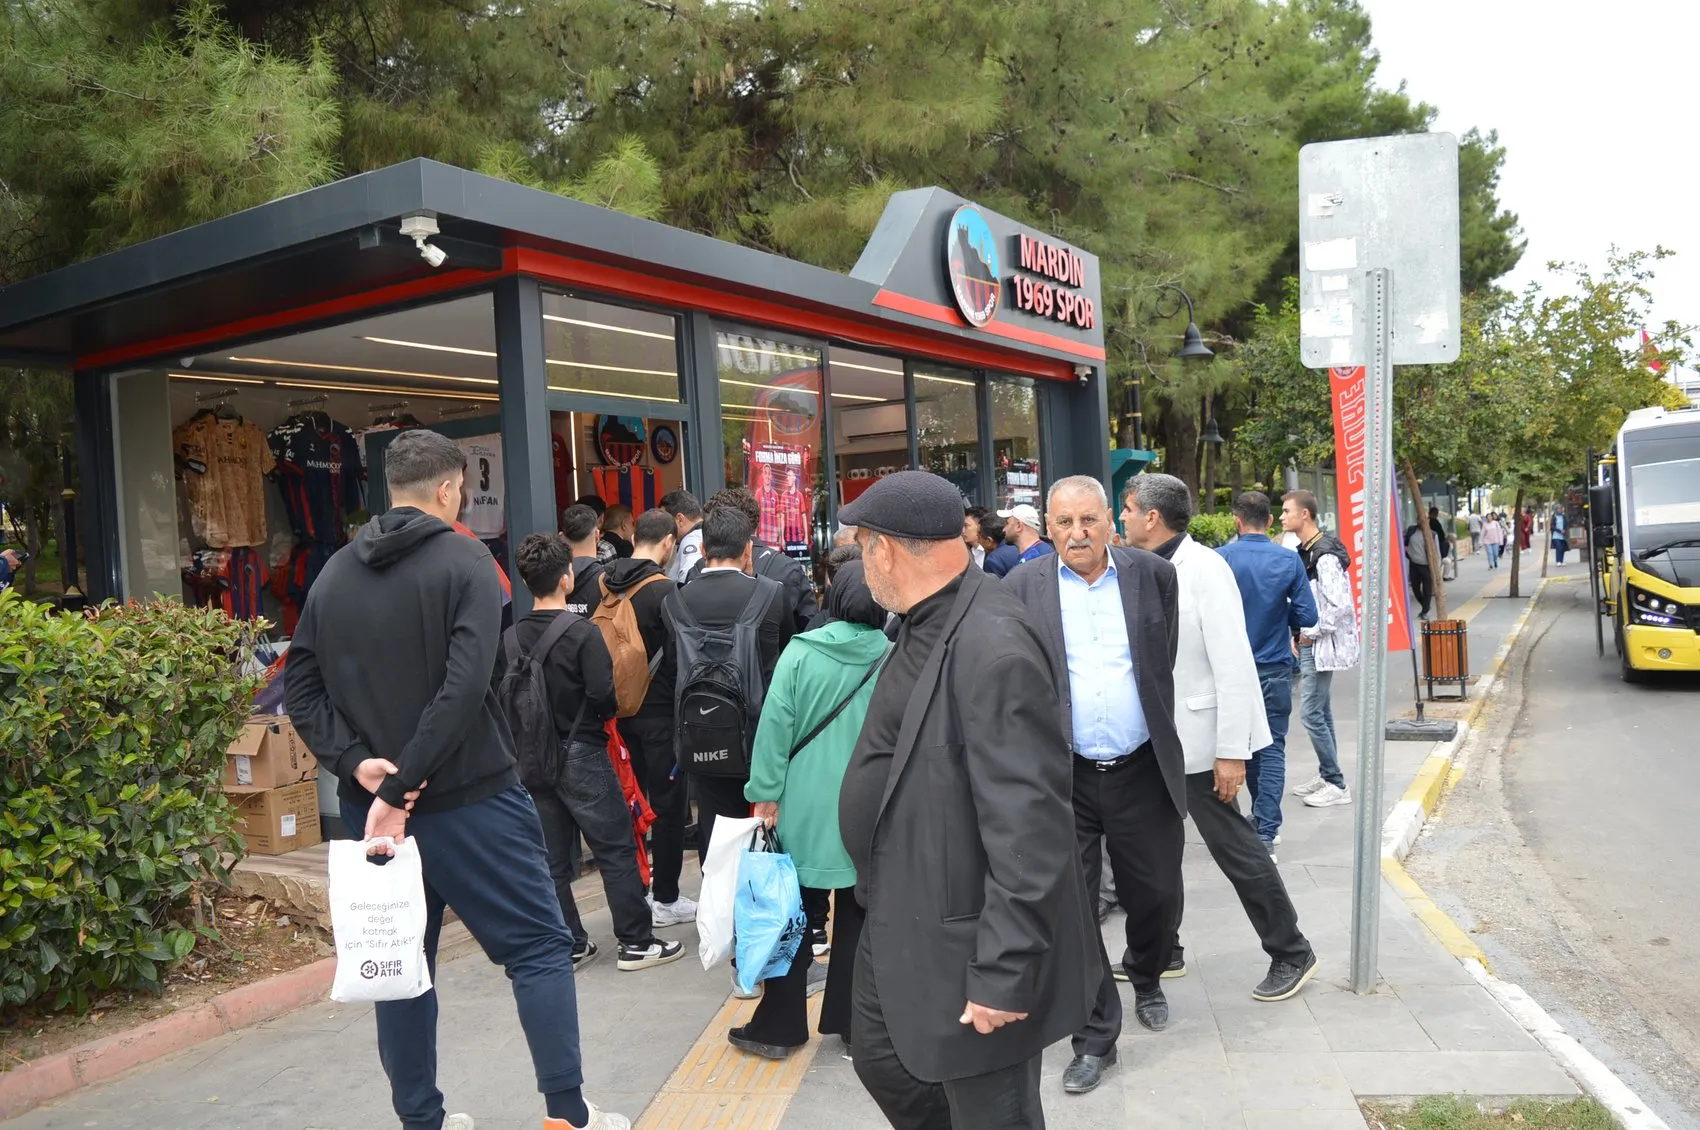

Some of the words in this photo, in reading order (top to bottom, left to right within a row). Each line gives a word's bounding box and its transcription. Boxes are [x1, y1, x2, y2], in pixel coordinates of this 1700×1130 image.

[1020, 233, 1084, 288] MARDİN
[1014, 274, 1053, 316] 1969
[1056, 287, 1095, 330] SPOR
[479, 457, 490, 492] 3
[693, 749, 729, 763] NIKE
[350, 901, 410, 912] Geleceğinize
[367, 915, 394, 925] değer
[362, 927, 398, 936] katmak
[345, 941, 363, 950] için
[380, 960, 402, 968] SIFIR
[380, 968, 402, 977] ATIK
